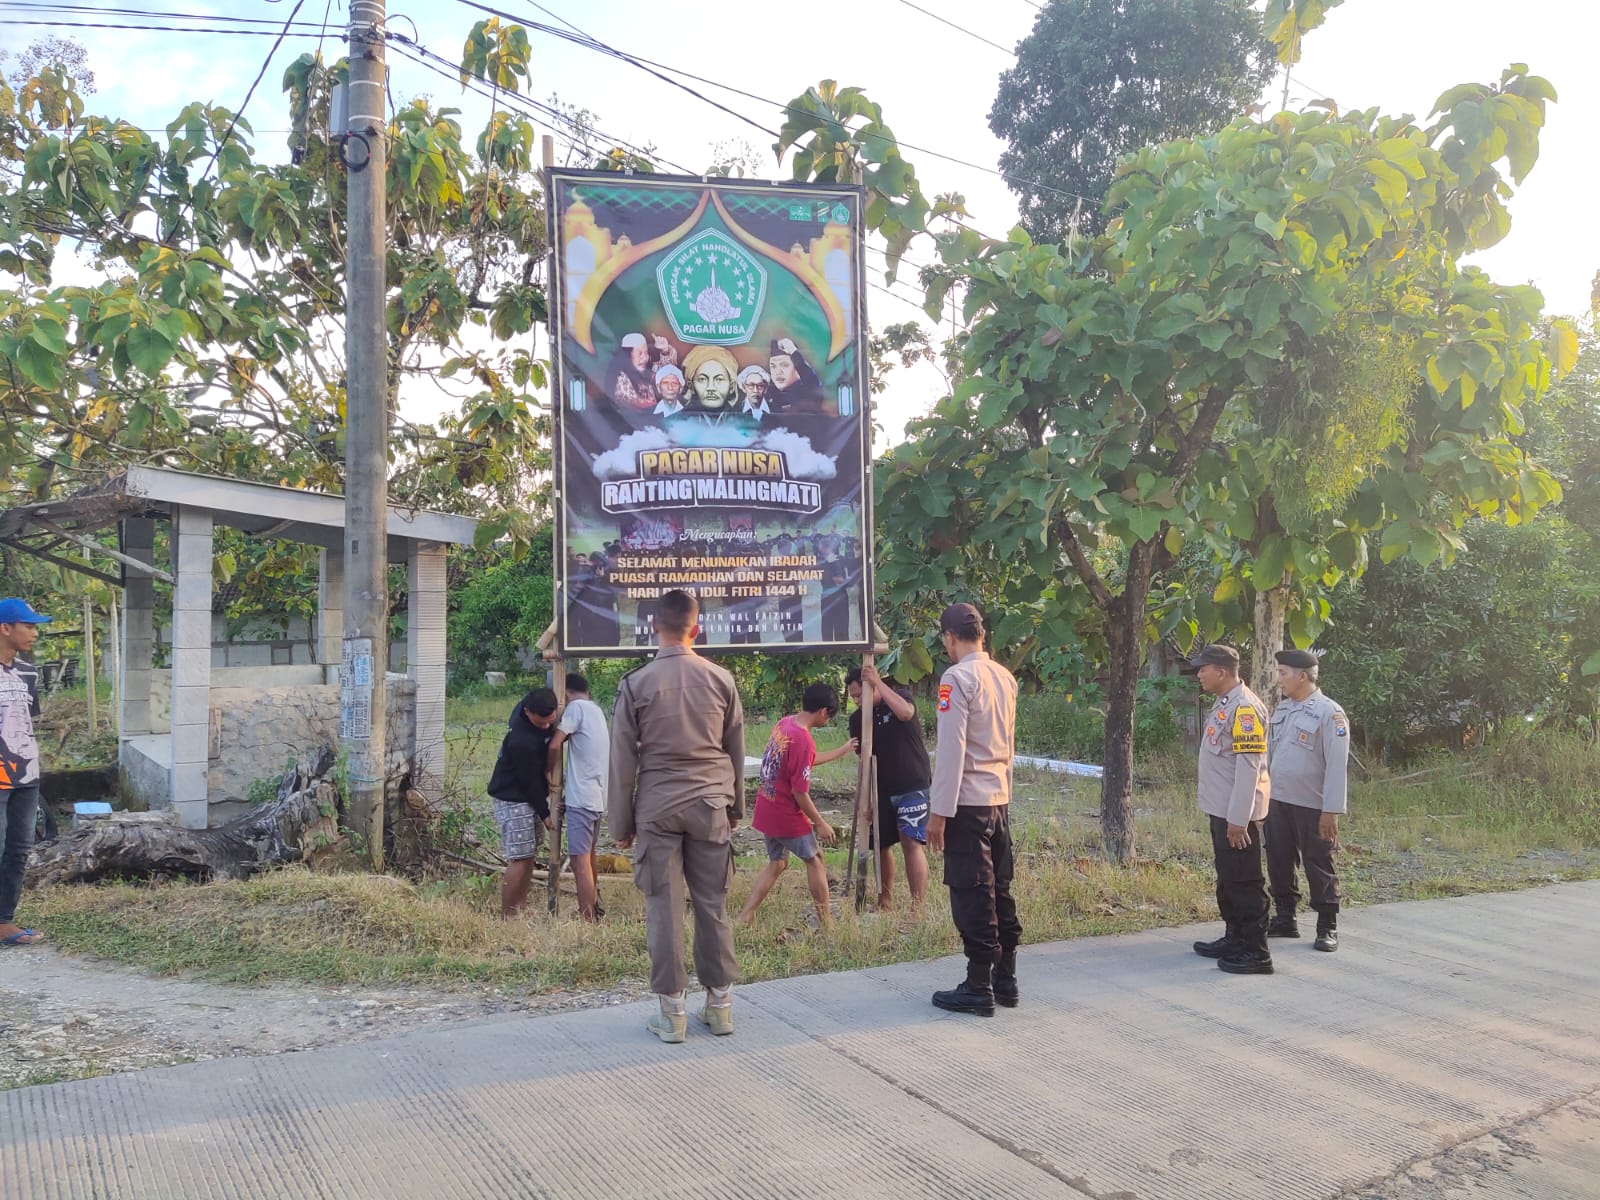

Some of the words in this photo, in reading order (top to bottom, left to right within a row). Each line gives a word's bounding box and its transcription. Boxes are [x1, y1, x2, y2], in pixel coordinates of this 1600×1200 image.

[678, 245, 699, 266] SILAT
[683, 324, 716, 334] PAGAR
[718, 324, 746, 334] NUSA
[643, 450, 718, 476] PAGAR
[722, 451, 783, 477] NUSA
[604, 479, 693, 506] RANTING
[699, 478, 818, 506] MALINGMATI
[617, 557, 678, 568] SELAMAT
[681, 556, 766, 567] MENUNAIKAN
[769, 555, 817, 566] IBADAH
[609, 572, 655, 583] PUASA
[659, 571, 734, 583] RAMADHAN
[736, 570, 764, 582] DAN
[767, 569, 824, 581] SELAMAT
[627, 587, 659, 598] HARI
[700, 586, 728, 598] IDUL
[731, 585, 762, 597] FITRI
[765, 585, 795, 596] 1444
[798, 585, 808, 596] H
[730, 612, 750, 621] WAL
[756, 611, 792, 621] FAIZIN
